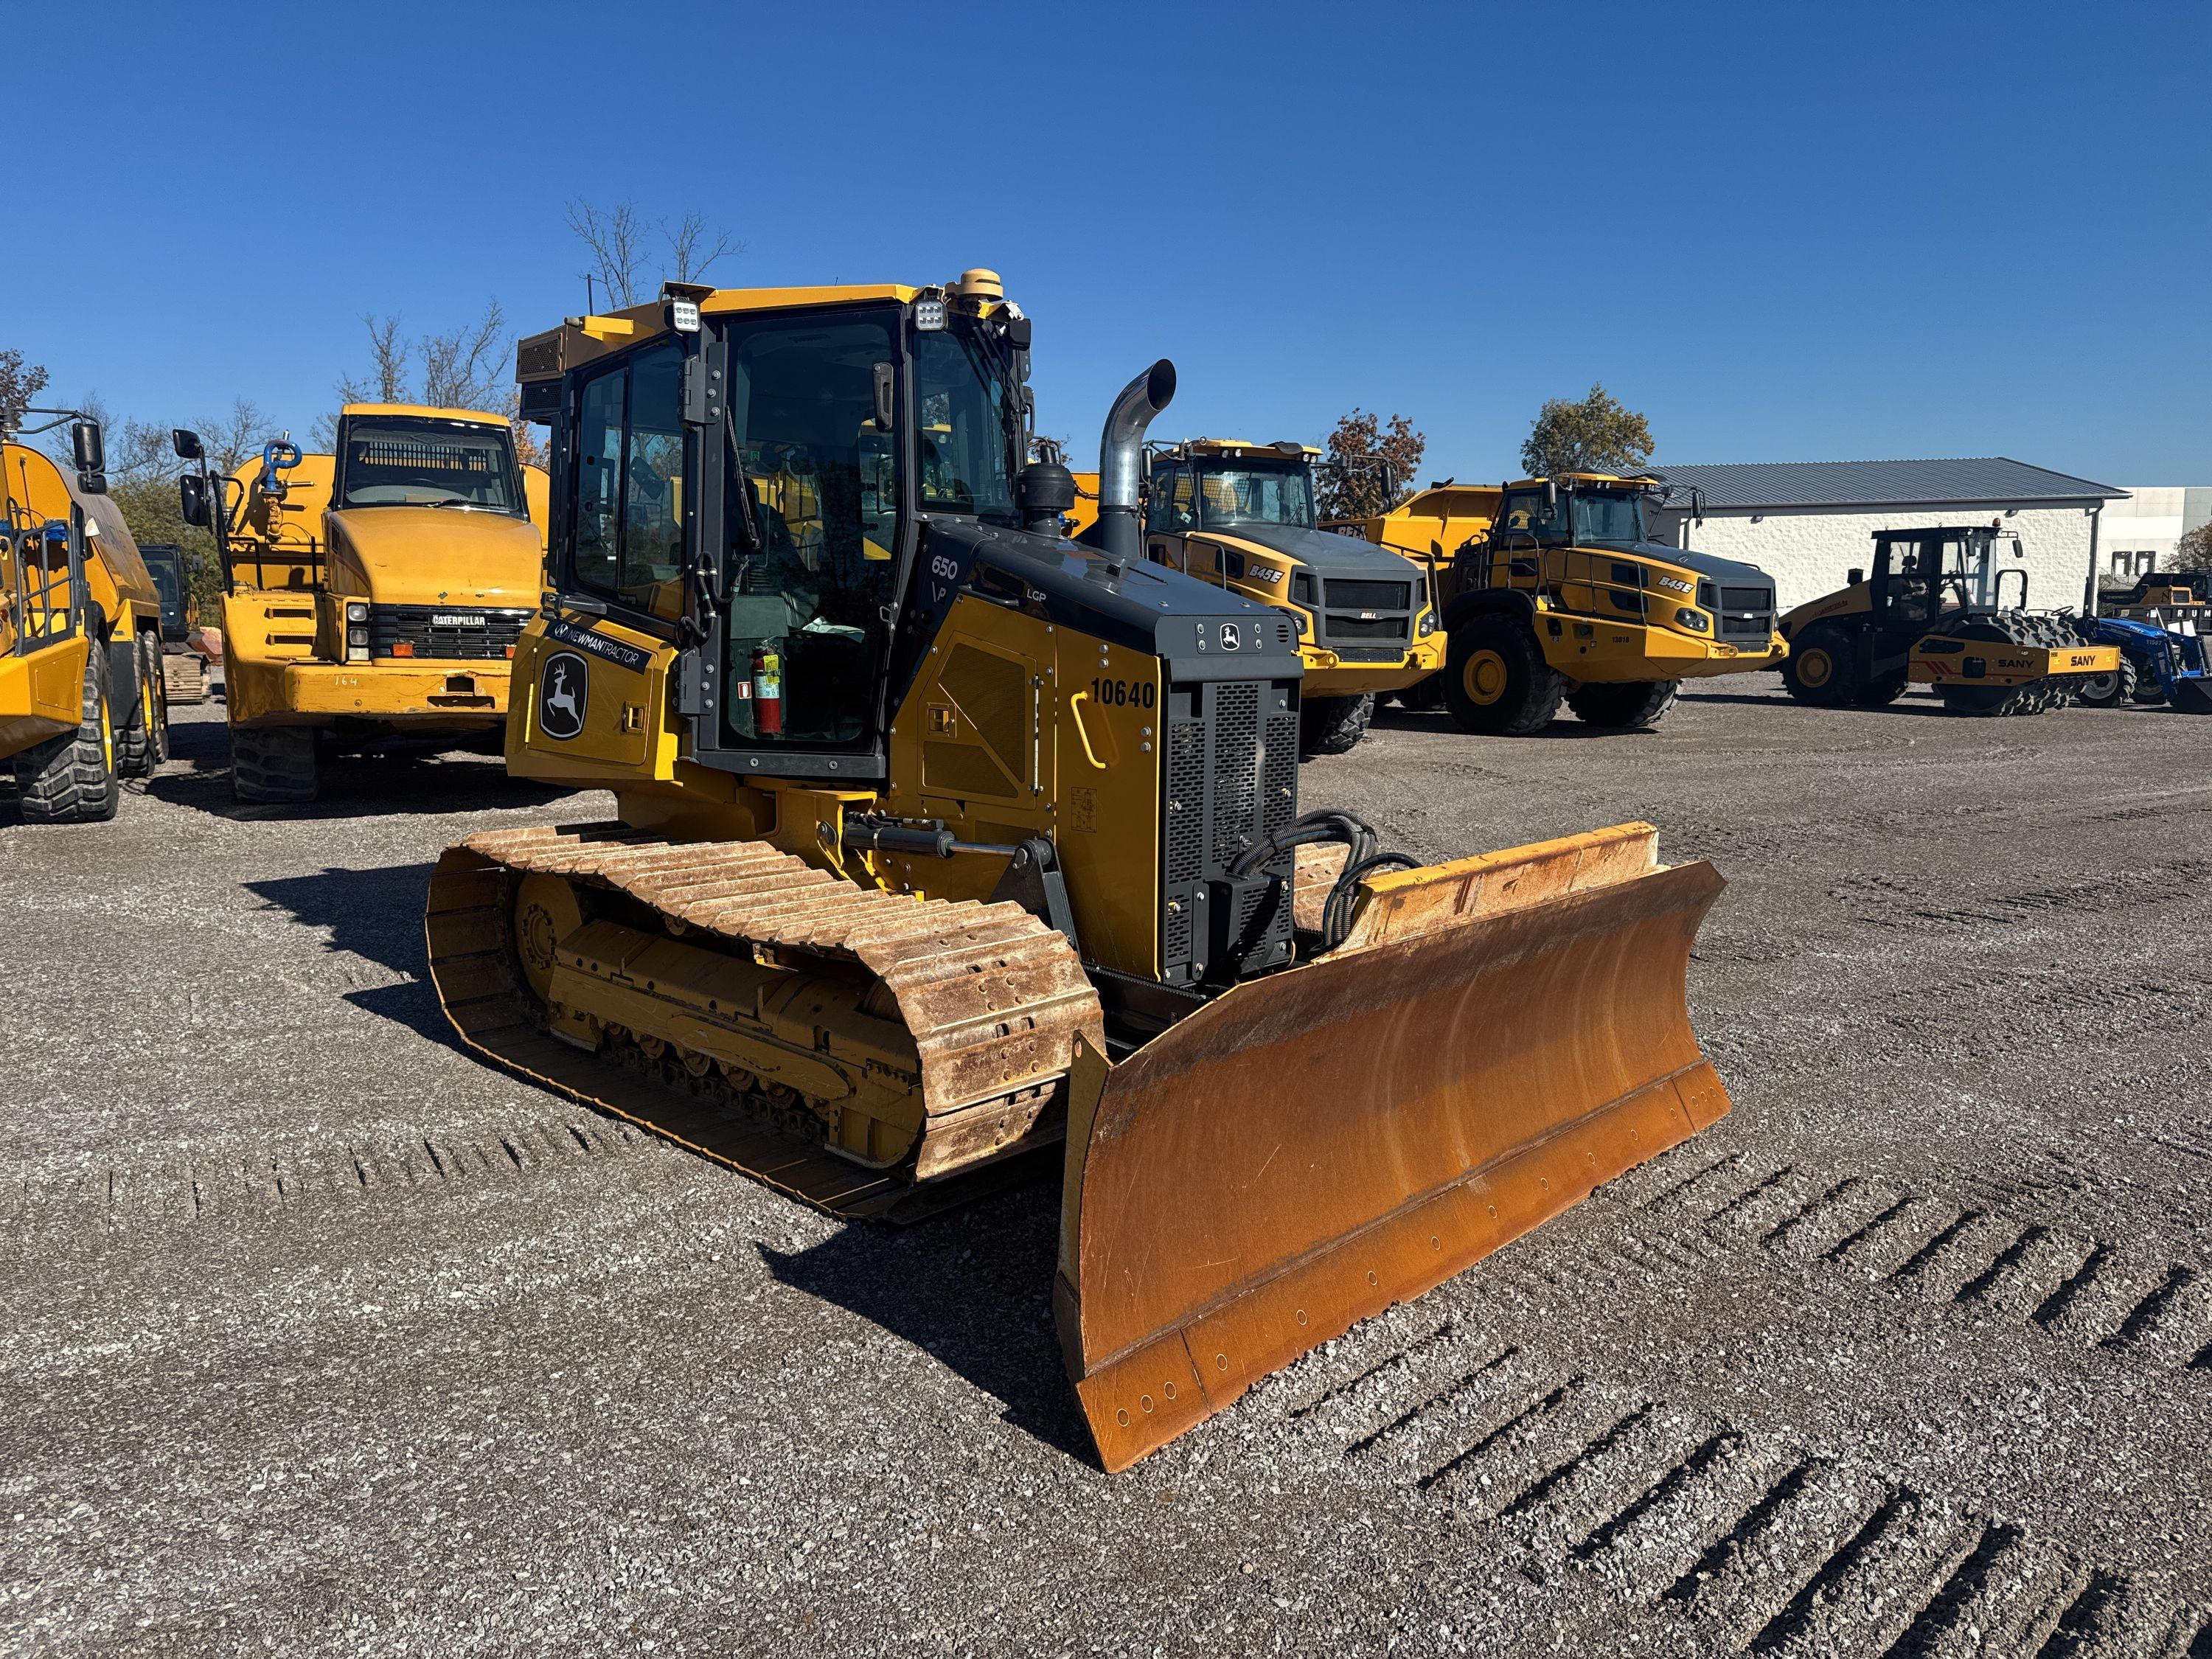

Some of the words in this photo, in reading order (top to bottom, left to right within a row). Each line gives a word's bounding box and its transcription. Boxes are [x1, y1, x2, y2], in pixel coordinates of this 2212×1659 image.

[932, 555, 958, 580] 650
[1250, 565, 1284, 583] B45E
[1660, 577, 1694, 594] B45E
[1026, 588, 1046, 602] LGP
[432, 615, 485, 626] CATERPILLAR
[1998, 659, 2034, 668] SANY
[2070, 655, 2096, 667] SANY
[335, 676, 357, 686] 164
[1091, 678, 1154, 709] 10640
